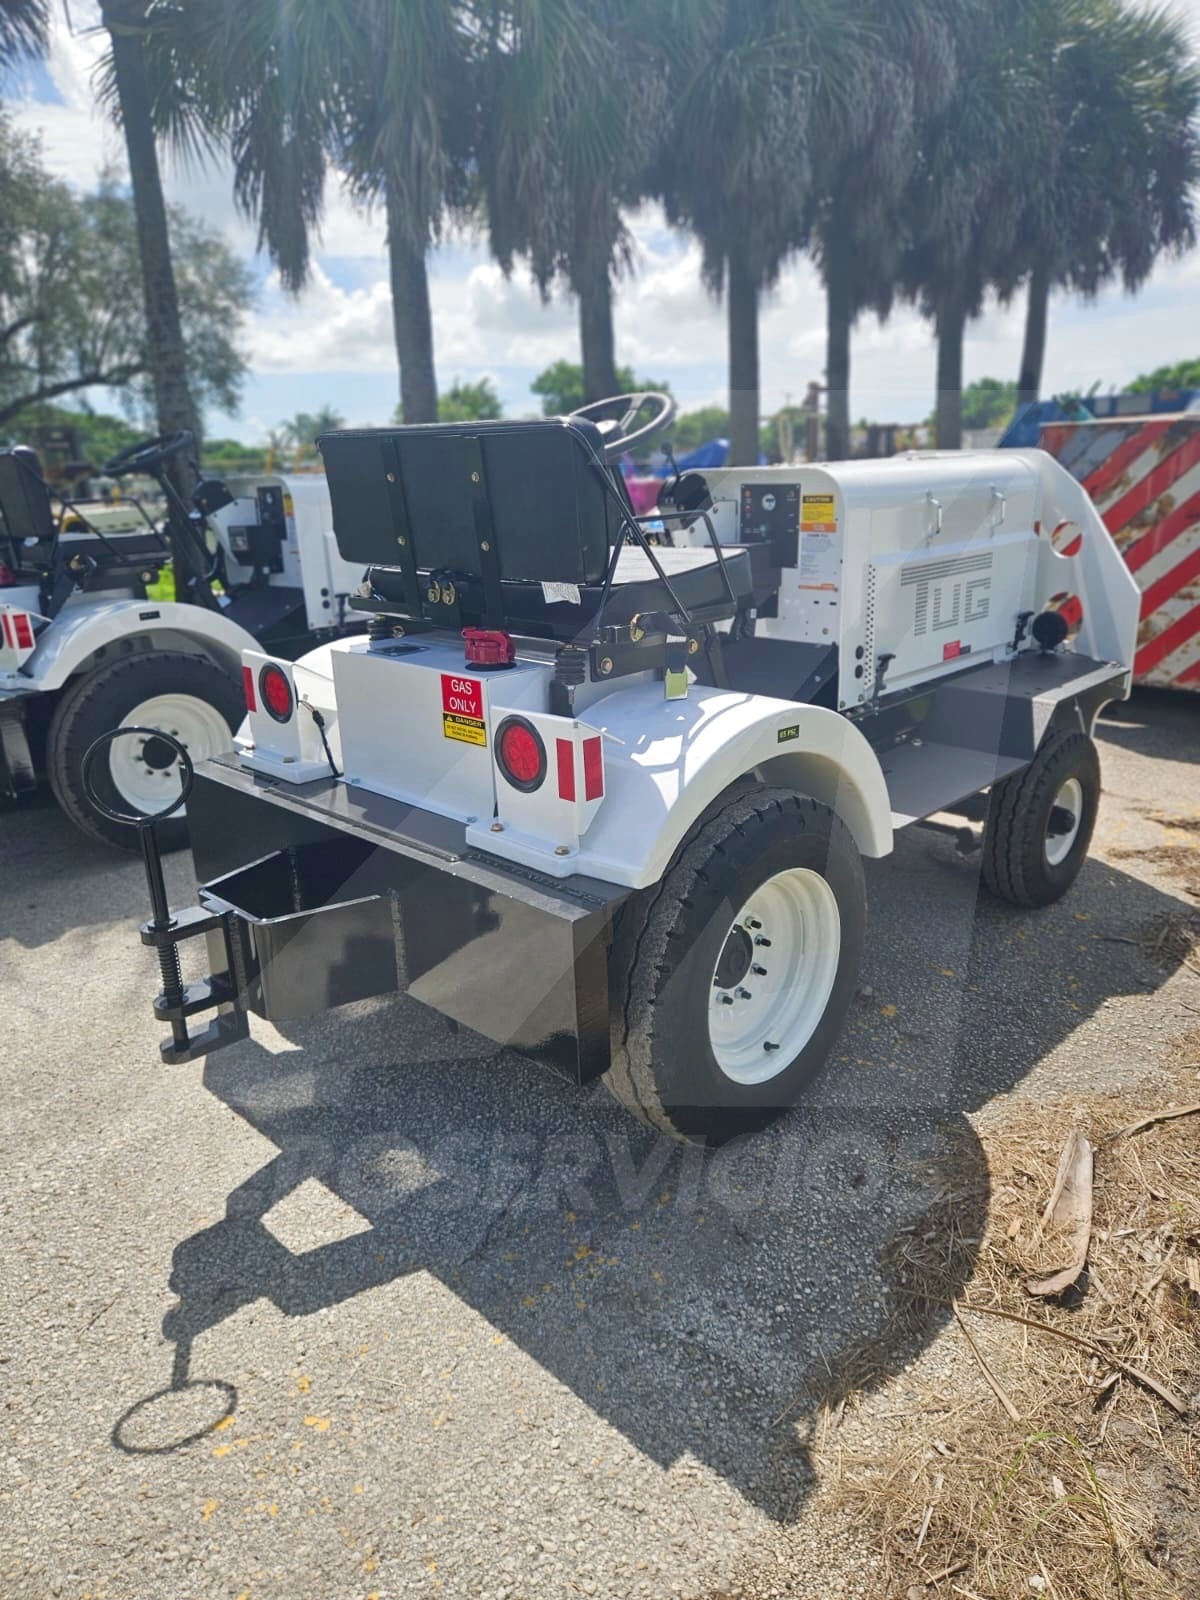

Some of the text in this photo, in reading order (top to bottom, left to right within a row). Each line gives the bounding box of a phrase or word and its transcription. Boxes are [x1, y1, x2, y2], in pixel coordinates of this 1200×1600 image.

[900, 552, 992, 637] TUG
[451, 679, 473, 695] GAS
[449, 696, 476, 714] ONLY
[455, 716, 482, 728] DANGER
